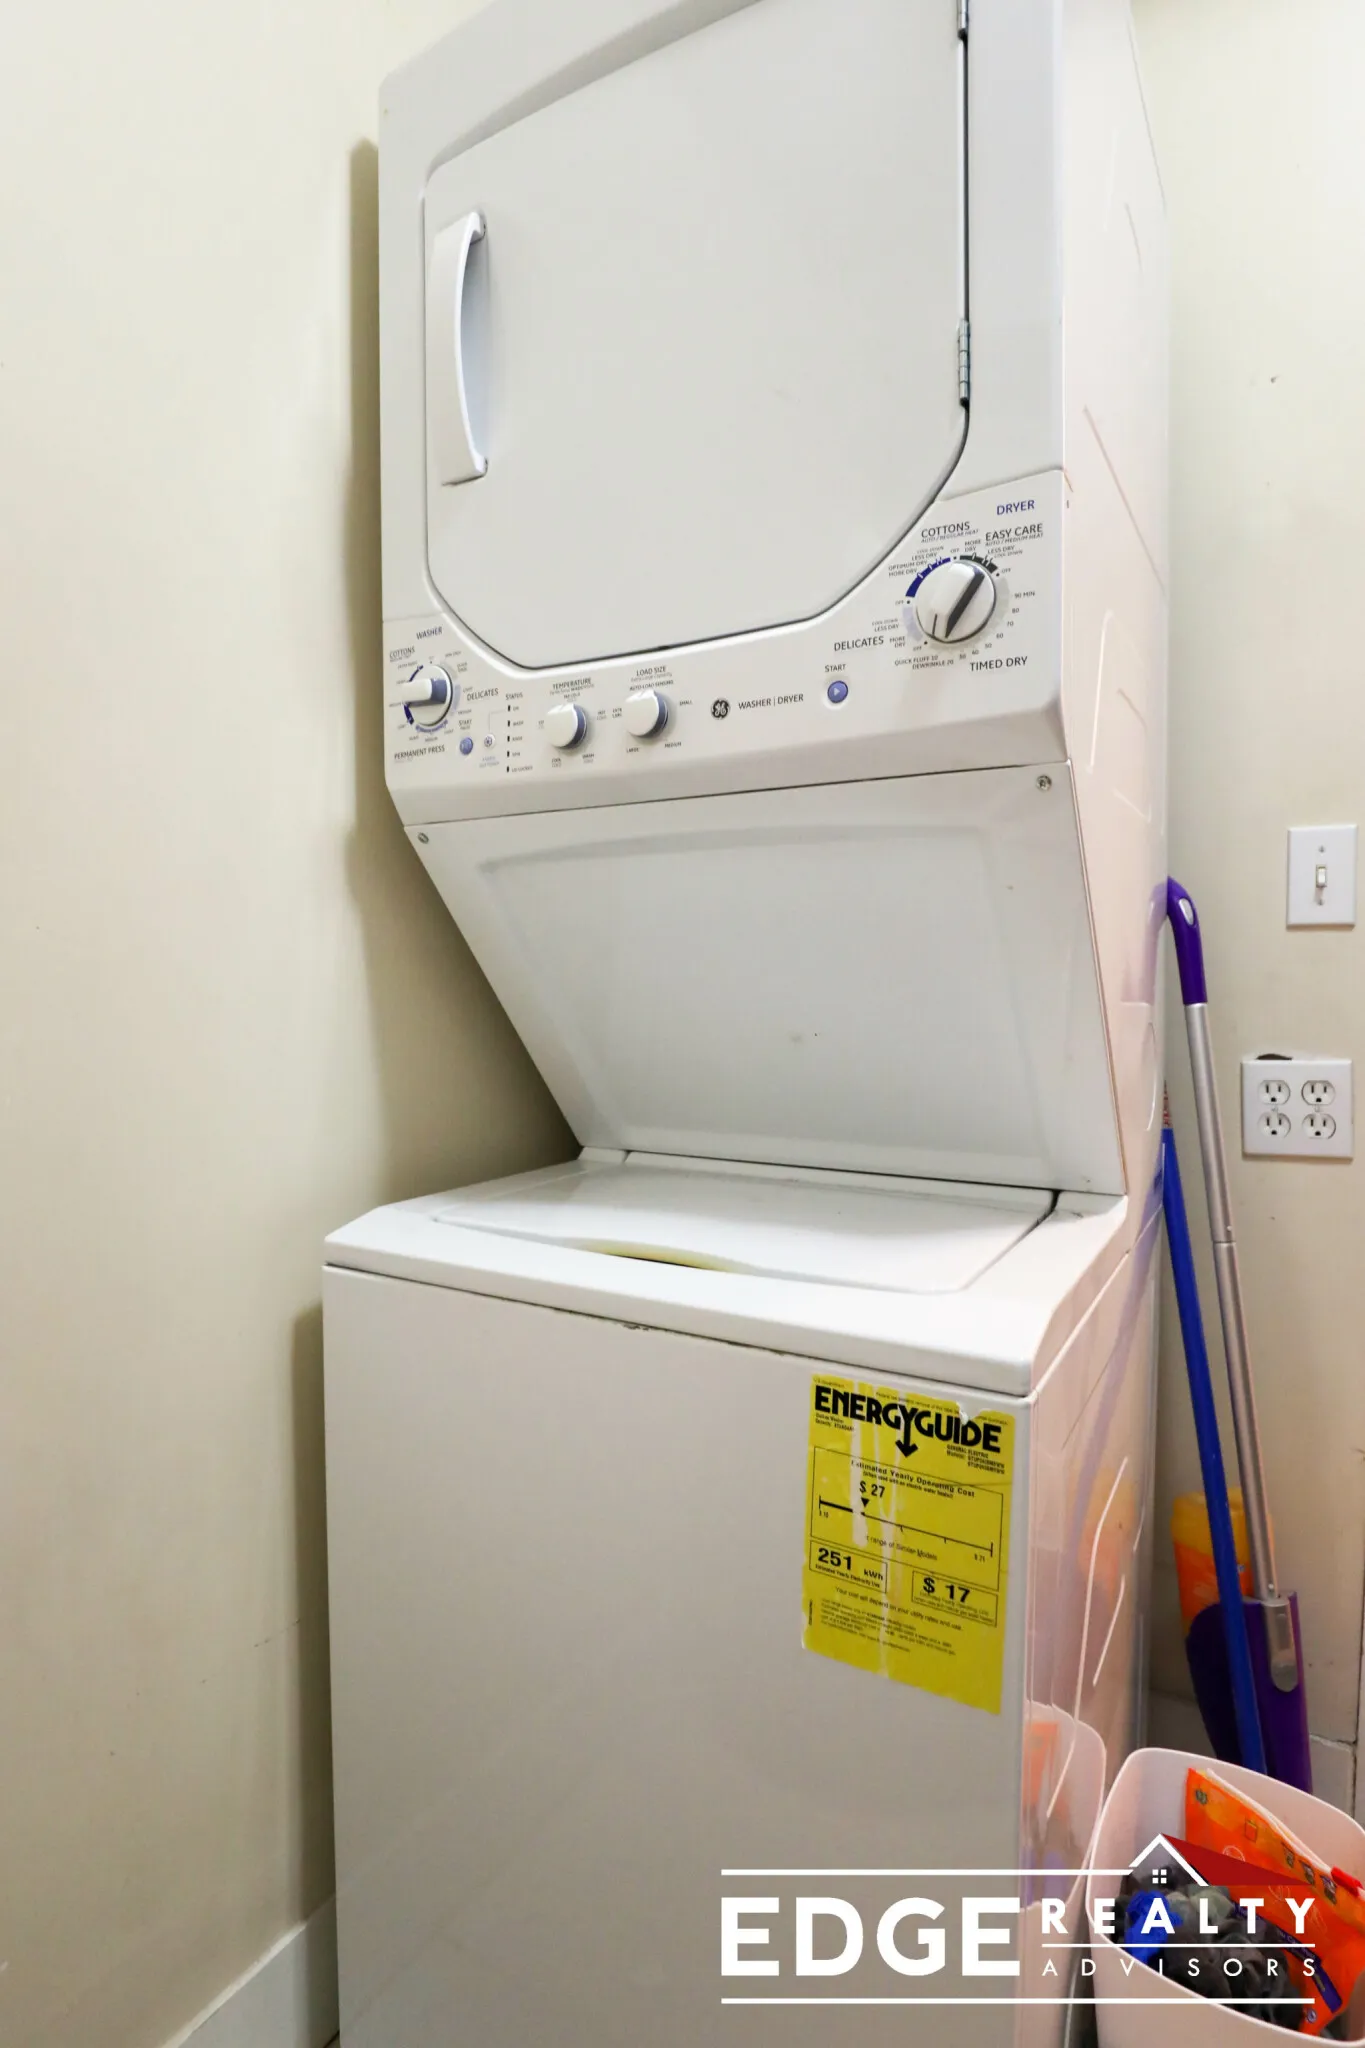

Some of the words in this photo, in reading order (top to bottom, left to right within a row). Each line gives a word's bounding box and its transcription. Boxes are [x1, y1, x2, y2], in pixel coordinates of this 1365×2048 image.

[997, 500, 1035, 515] DRYER
[921, 521, 970, 538] COTTONS
[985, 528, 1012, 542] EASY
[1014, 523, 1043, 536] CARE
[940, 532, 964, 541] REGULAR
[1006, 535, 1028, 544] MEDIUM
[1030, 532, 1044, 540] HEAT
[888, 562, 915, 571] OPTIMUM
[416, 627, 442, 640] WASHER
[874, 624, 886, 632] LESS
[834, 635, 884, 651] DELICATES
[889, 636, 905, 644] MORE
[390, 646, 415, 659] COTTONS
[825, 664, 846, 672] START
[894, 658, 912, 666] QUICK
[912, 660, 945, 670] DEWRINKLE
[970, 658, 1003, 672] TIMED
[1006, 656, 1028, 668] DRY
[636, 667, 652, 676] LOAD
[553, 678, 592, 690] TEMPERATURE
[467, 688, 499, 701] DELICATES
[506, 692, 523, 700] STATUS
[738, 698, 771, 710] WASHER
[777, 694, 804, 705] DRYER
[394, 748, 427, 760] PERMANENT
[428, 745, 445, 754] PRESS
[815, 1385, 1001, 1453] ENERGYGUIDE
[947, 1444, 967, 1453] GENERAL
[968, 1449, 988, 1458] ELECTRIC
[859, 1480, 866, 1493] $
[871, 1484, 885, 1498] 27
[890, 1470, 914, 1482] Yearly
[917, 1476, 954, 1492] Operating
[957, 1487, 975, 1497] Cost
[917, 1549, 937, 1560] Models
[818, 1547, 851, 1570] 251
[864, 1568, 883, 1580] kWh
[923, 1576, 935, 1593] $
[945, 1584, 970, 1603] 17
[836, 1586, 847, 1595] Your
[869, 1596, 888, 1608] depend
